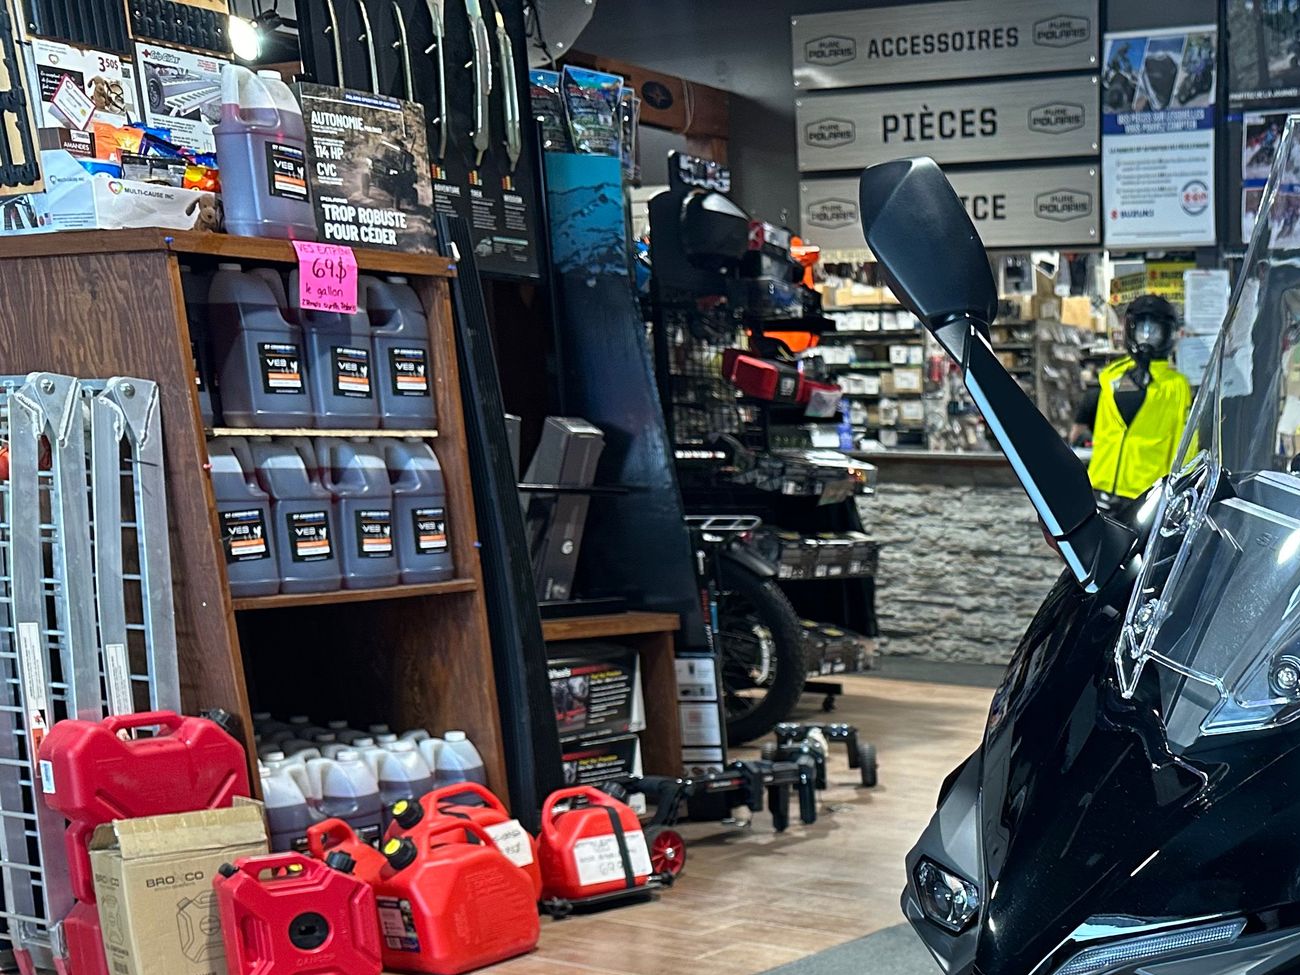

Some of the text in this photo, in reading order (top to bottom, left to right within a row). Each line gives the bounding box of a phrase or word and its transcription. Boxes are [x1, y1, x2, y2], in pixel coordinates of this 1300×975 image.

[1037, 27, 1087, 39] POLARIS
[867, 26, 1019, 59] ACCESSOIRES
[808, 47, 853, 58] POLARIS
[311, 111, 364, 131] AUTONOMIE
[882, 105, 998, 144] PIÈCES
[1031, 114, 1081, 126] POLARIS
[808, 130, 853, 141] POLARIS
[63, 141, 90, 151] AMANDES
[332, 147, 344, 161] HP
[316, 162, 338, 177] CVC
[124, 187, 163, 199] MULTI-CAUSE
[1039, 201, 1088, 214] POLARIS
[322, 204, 408, 229] TROP ROBUSTE
[810, 209, 858, 221] POLARIS
[324, 222, 398, 245] POUR CÉDER
[312, 256, 347, 284] 69$
[317, 285, 343, 299] gallon
[146, 871, 204, 888] BROCO
